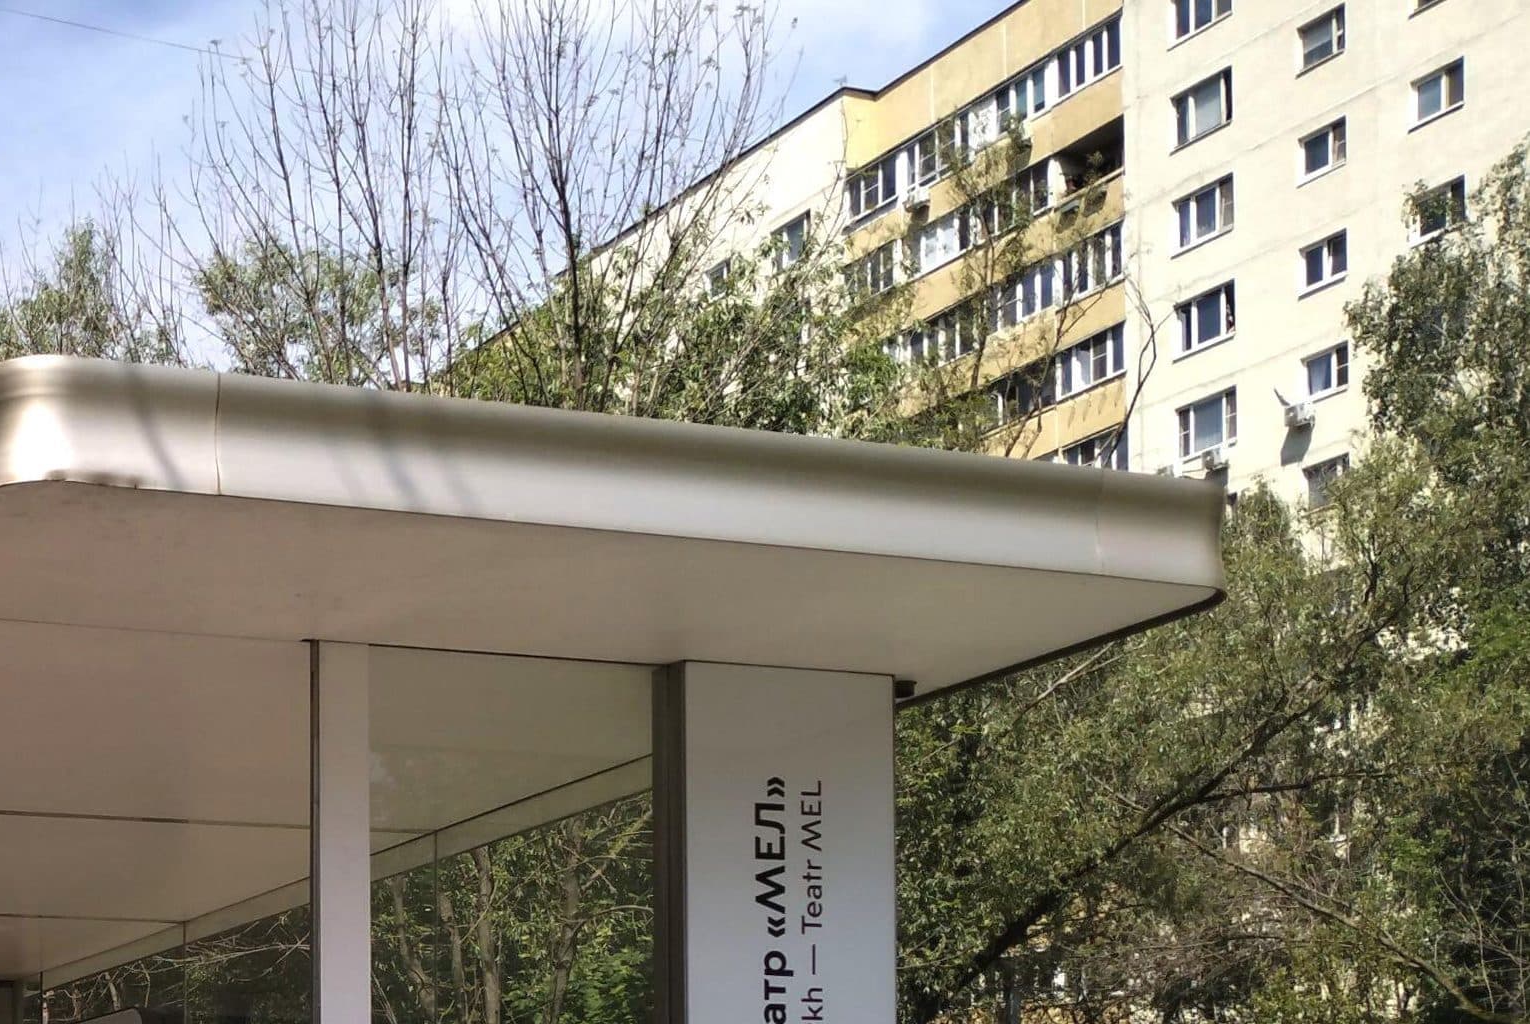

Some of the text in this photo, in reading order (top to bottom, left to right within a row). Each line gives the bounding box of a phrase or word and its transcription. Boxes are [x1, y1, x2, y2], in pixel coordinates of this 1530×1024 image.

[800, 780, 822, 852] MEL
[754, 776, 786, 938] «МЕЛ»
[801, 859, 823, 934] Teatr
